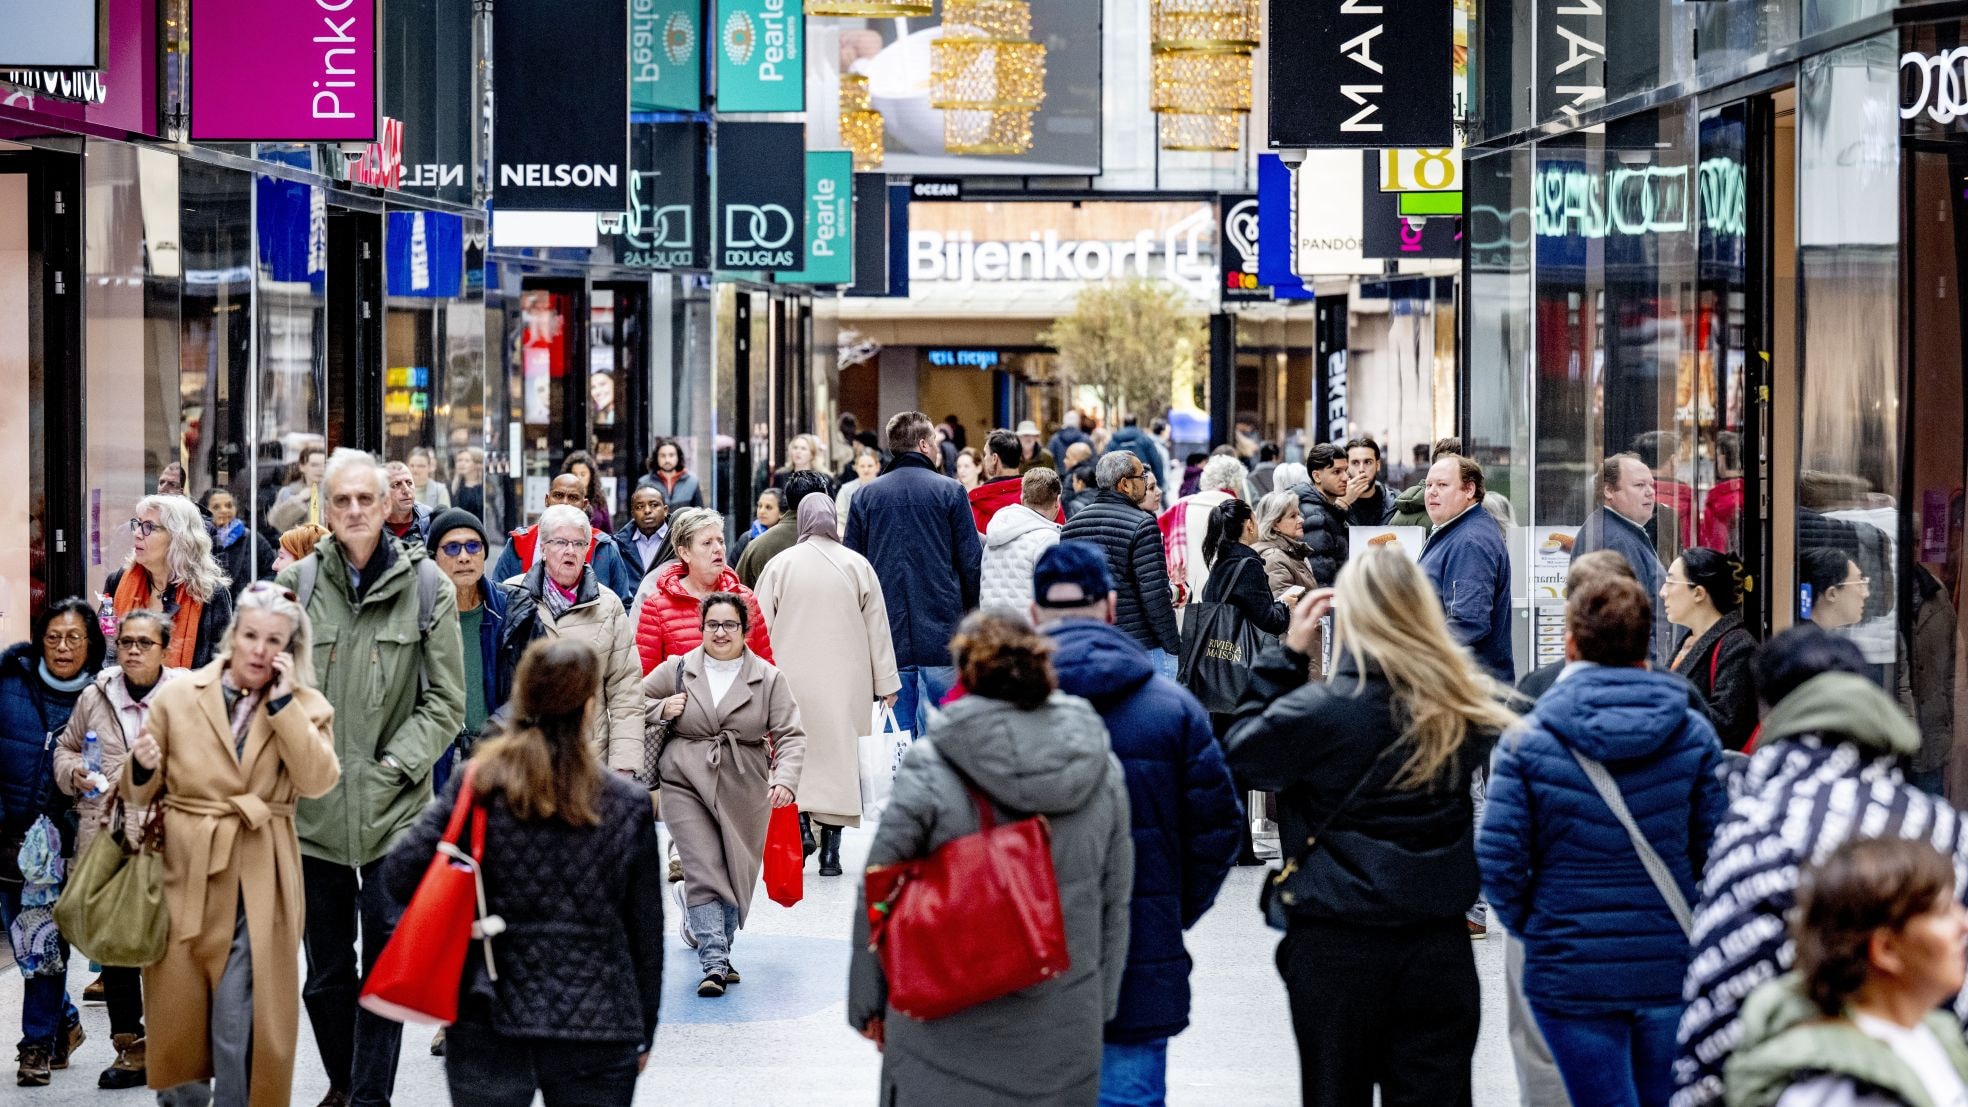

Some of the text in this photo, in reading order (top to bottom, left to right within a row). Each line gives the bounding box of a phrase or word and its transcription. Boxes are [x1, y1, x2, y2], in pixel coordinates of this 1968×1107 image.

[313, 0, 356, 119] Pink
[500, 163, 618, 188] NELSON
[914, 183, 959, 196] OCEAN
[813, 178, 836, 257] Pearle
[725, 250, 794, 266] DOUGLAS
[908, 228, 1155, 288] Bijenkorf
[1205, 647, 1242, 662] MAISON
